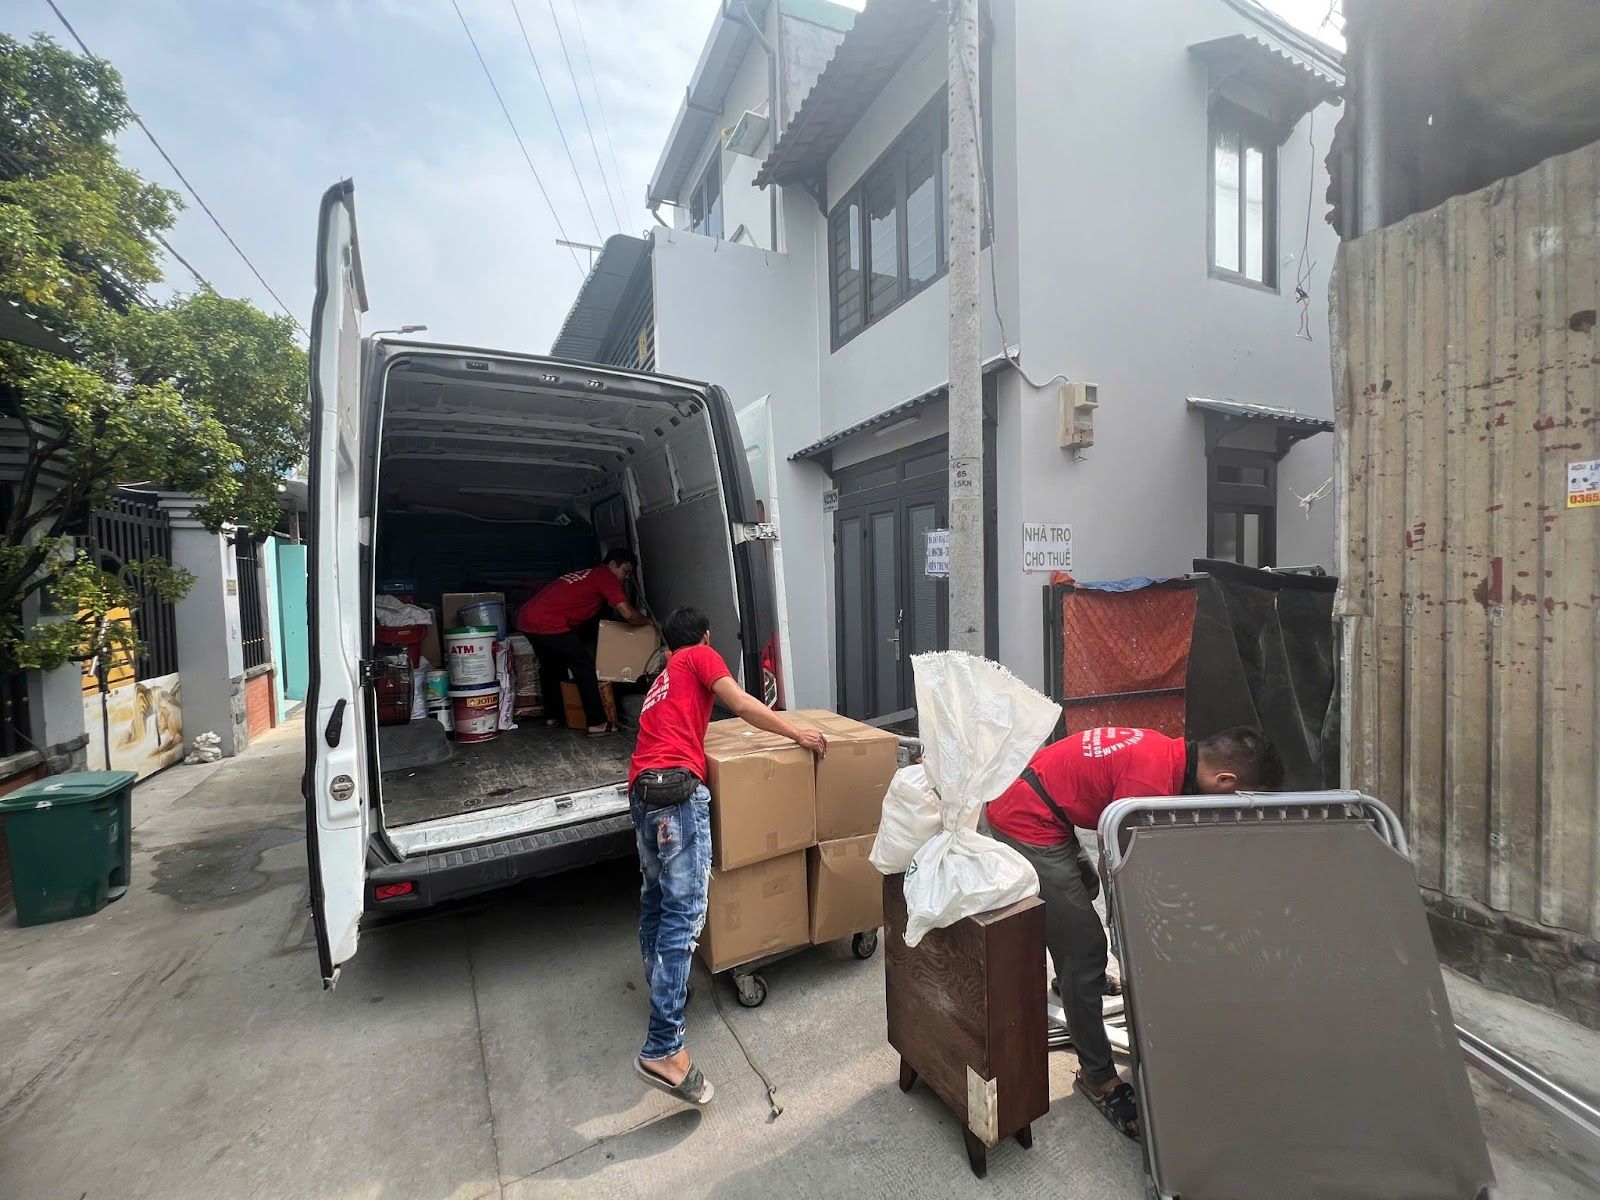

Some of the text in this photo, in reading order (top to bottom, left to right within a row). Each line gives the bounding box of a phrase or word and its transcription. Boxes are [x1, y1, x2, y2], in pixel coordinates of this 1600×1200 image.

[1025, 524, 1071, 546] NHÀ TRỌ
[1025, 548, 1071, 567] CHO THUÊ
[451, 645, 474, 654] ATM
